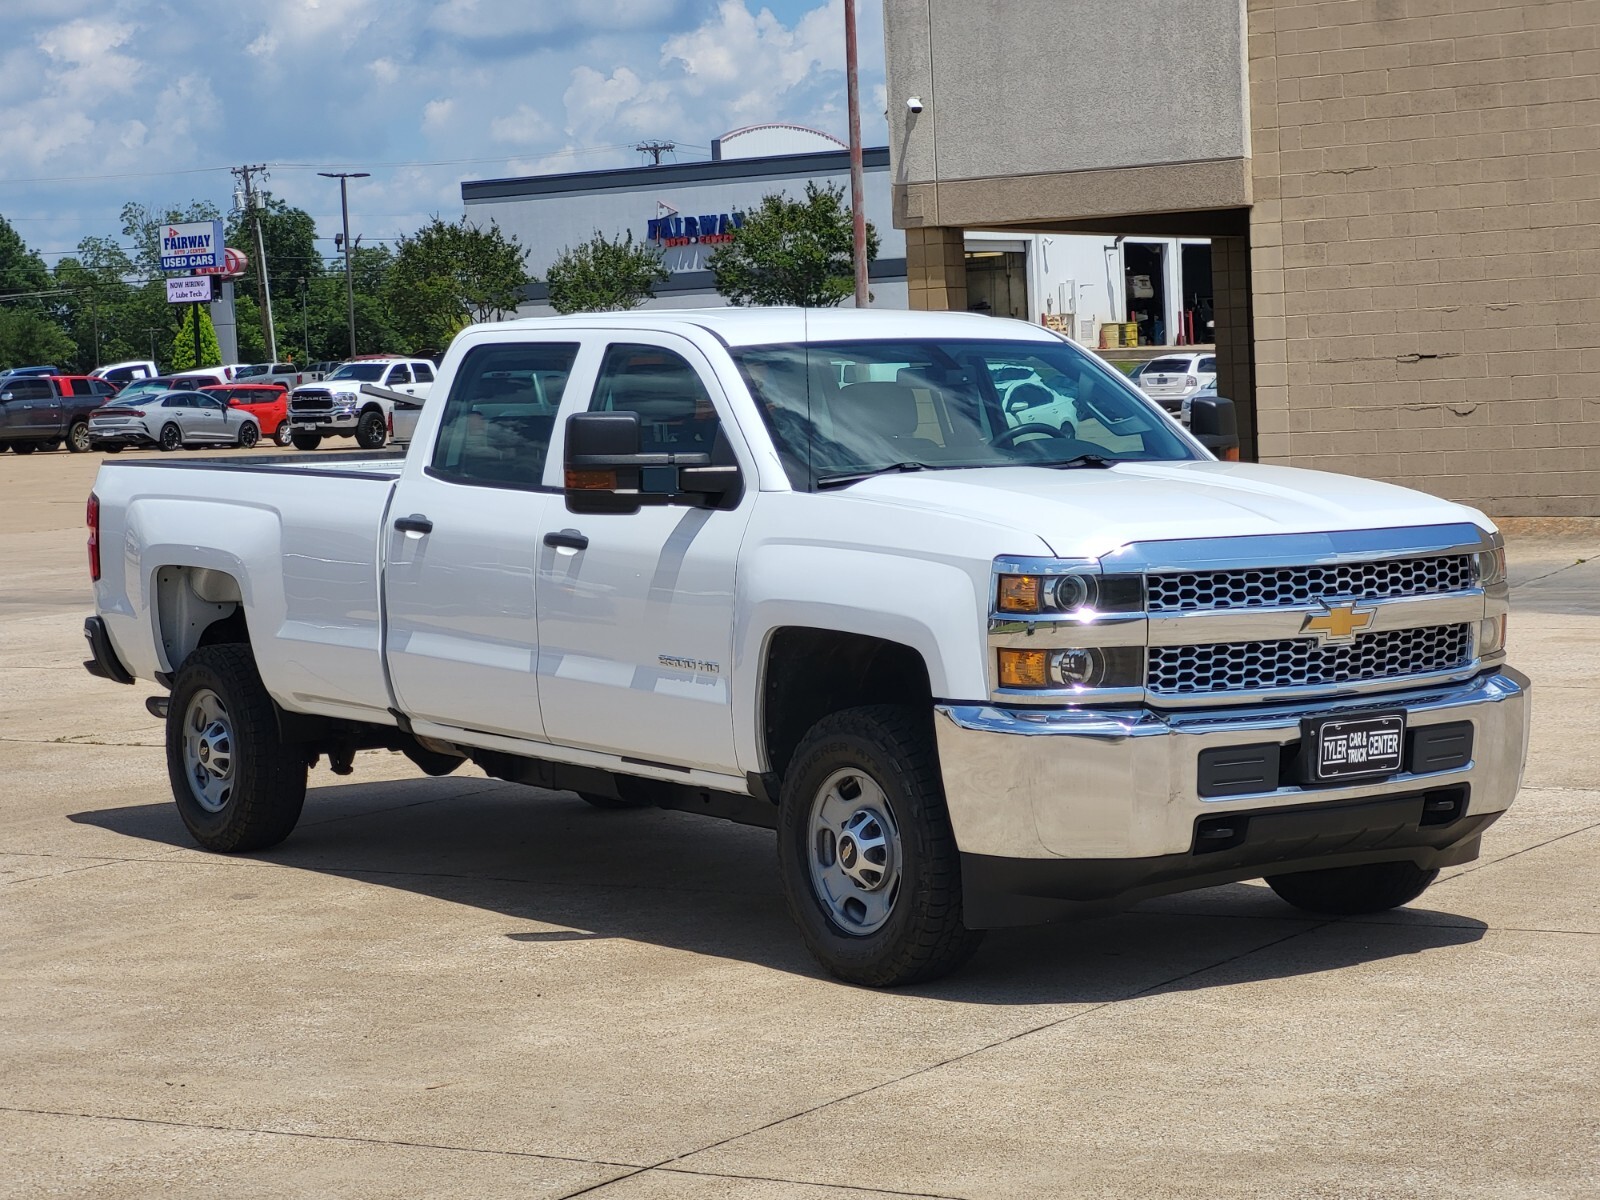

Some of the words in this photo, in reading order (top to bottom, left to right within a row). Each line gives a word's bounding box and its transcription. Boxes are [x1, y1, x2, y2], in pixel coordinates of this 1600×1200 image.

[648, 212, 746, 240] FAIRWAY
[164, 235, 210, 250] FAIRWAY
[665, 237, 689, 247] AUTO
[163, 256, 188, 268] USED
[189, 254, 214, 266] CARS
[169, 281, 184, 289] NOW
[189, 289, 203, 298] Tech
[1349, 732, 1362, 747] CAR
[1362, 731, 1367, 746] &
[1368, 734, 1398, 755] CENTER
[1324, 740, 1347, 760] TYLER
[1347, 748, 1368, 764] TRUCK
